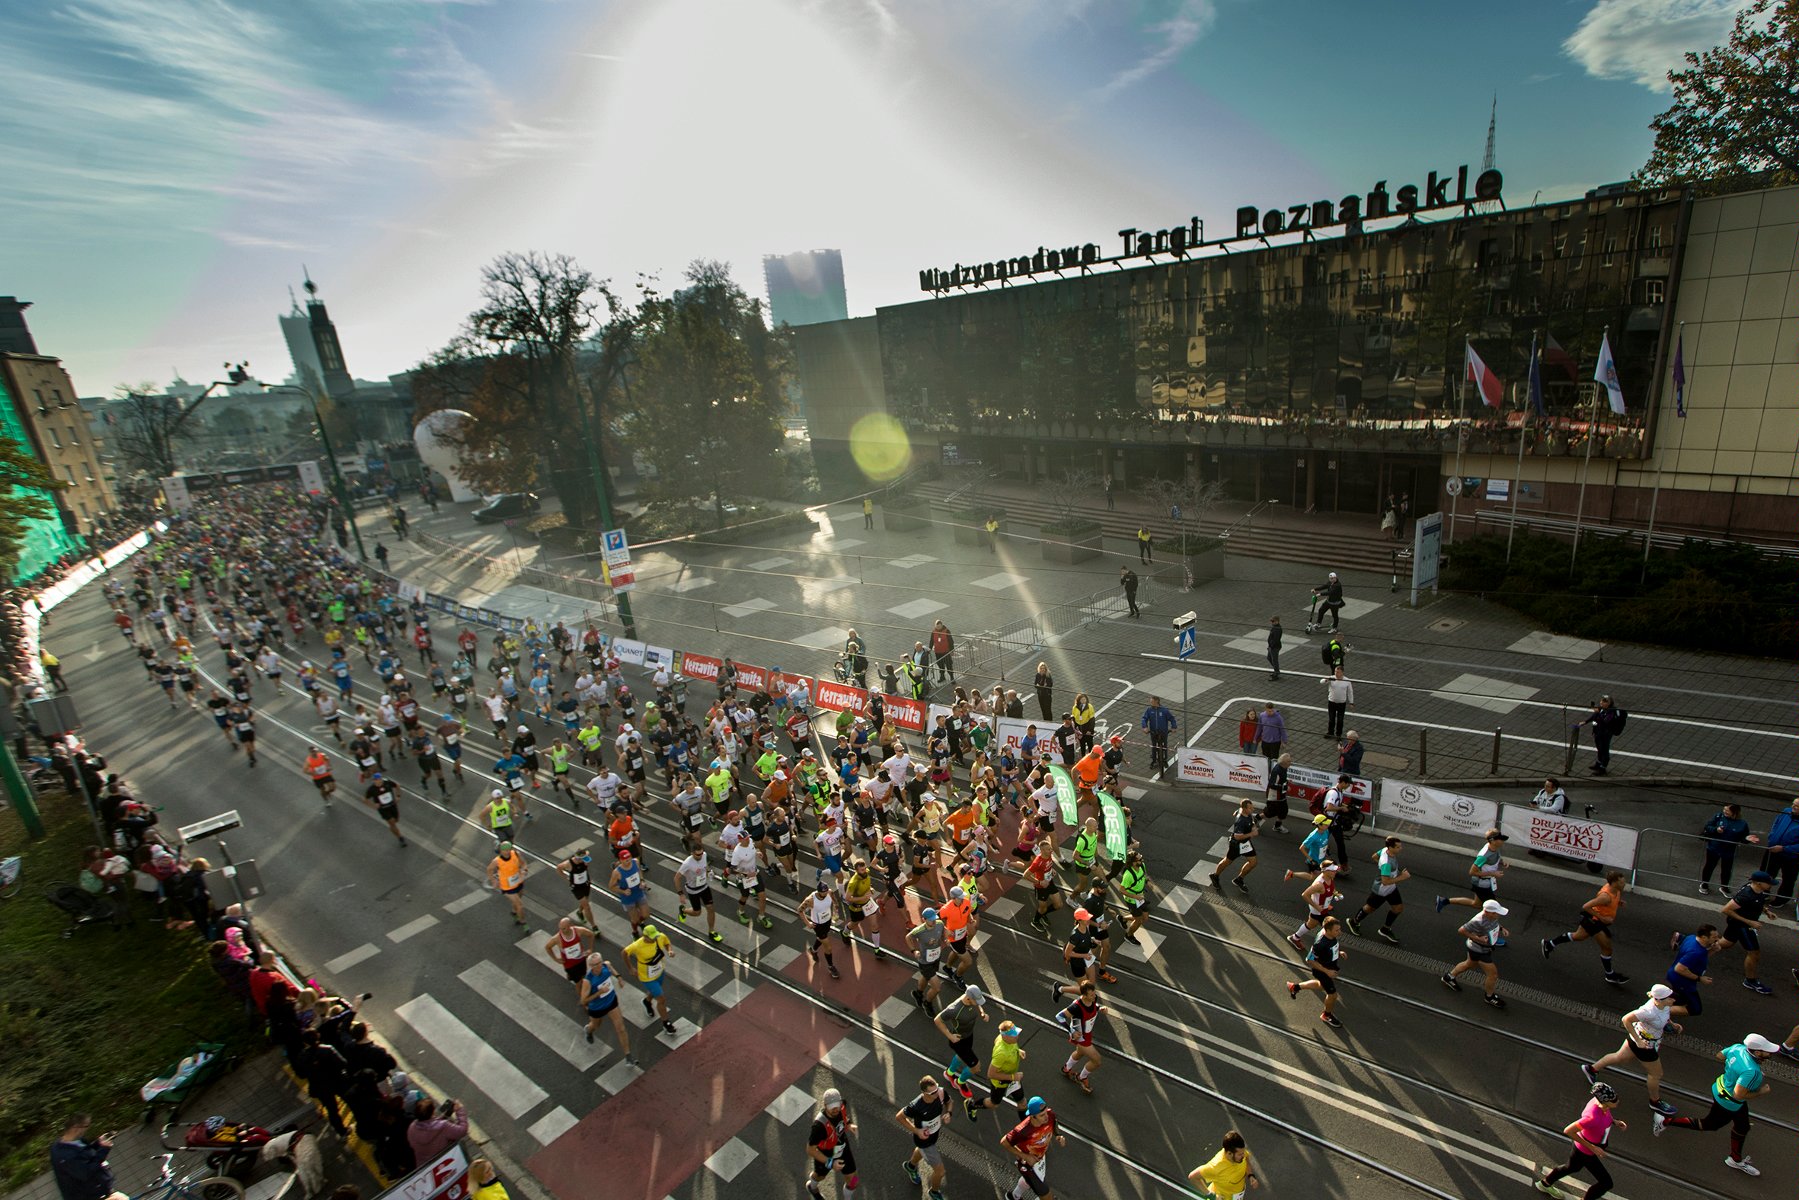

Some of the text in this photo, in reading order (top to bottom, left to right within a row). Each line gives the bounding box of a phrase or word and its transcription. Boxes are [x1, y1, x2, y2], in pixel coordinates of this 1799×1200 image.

[1118, 216, 1202, 257] Targi
[1236, 164, 1503, 239] Poznańskie
[685, 658, 719, 678] terravita
[819, 687, 863, 711] terravita
[1183, 765, 1215, 773] MARATONY
[1183, 770, 1215, 778] POLSKIE.PL
[1229, 771, 1262, 780] MARATONY
[1229, 776, 1262, 785] POLSKIE.PL
[1531, 817, 1590, 836] DRUŻYNA
[1530, 827, 1603, 851] SZPIKU
[1530, 840, 1596, 860] www.darszpiku.pl
